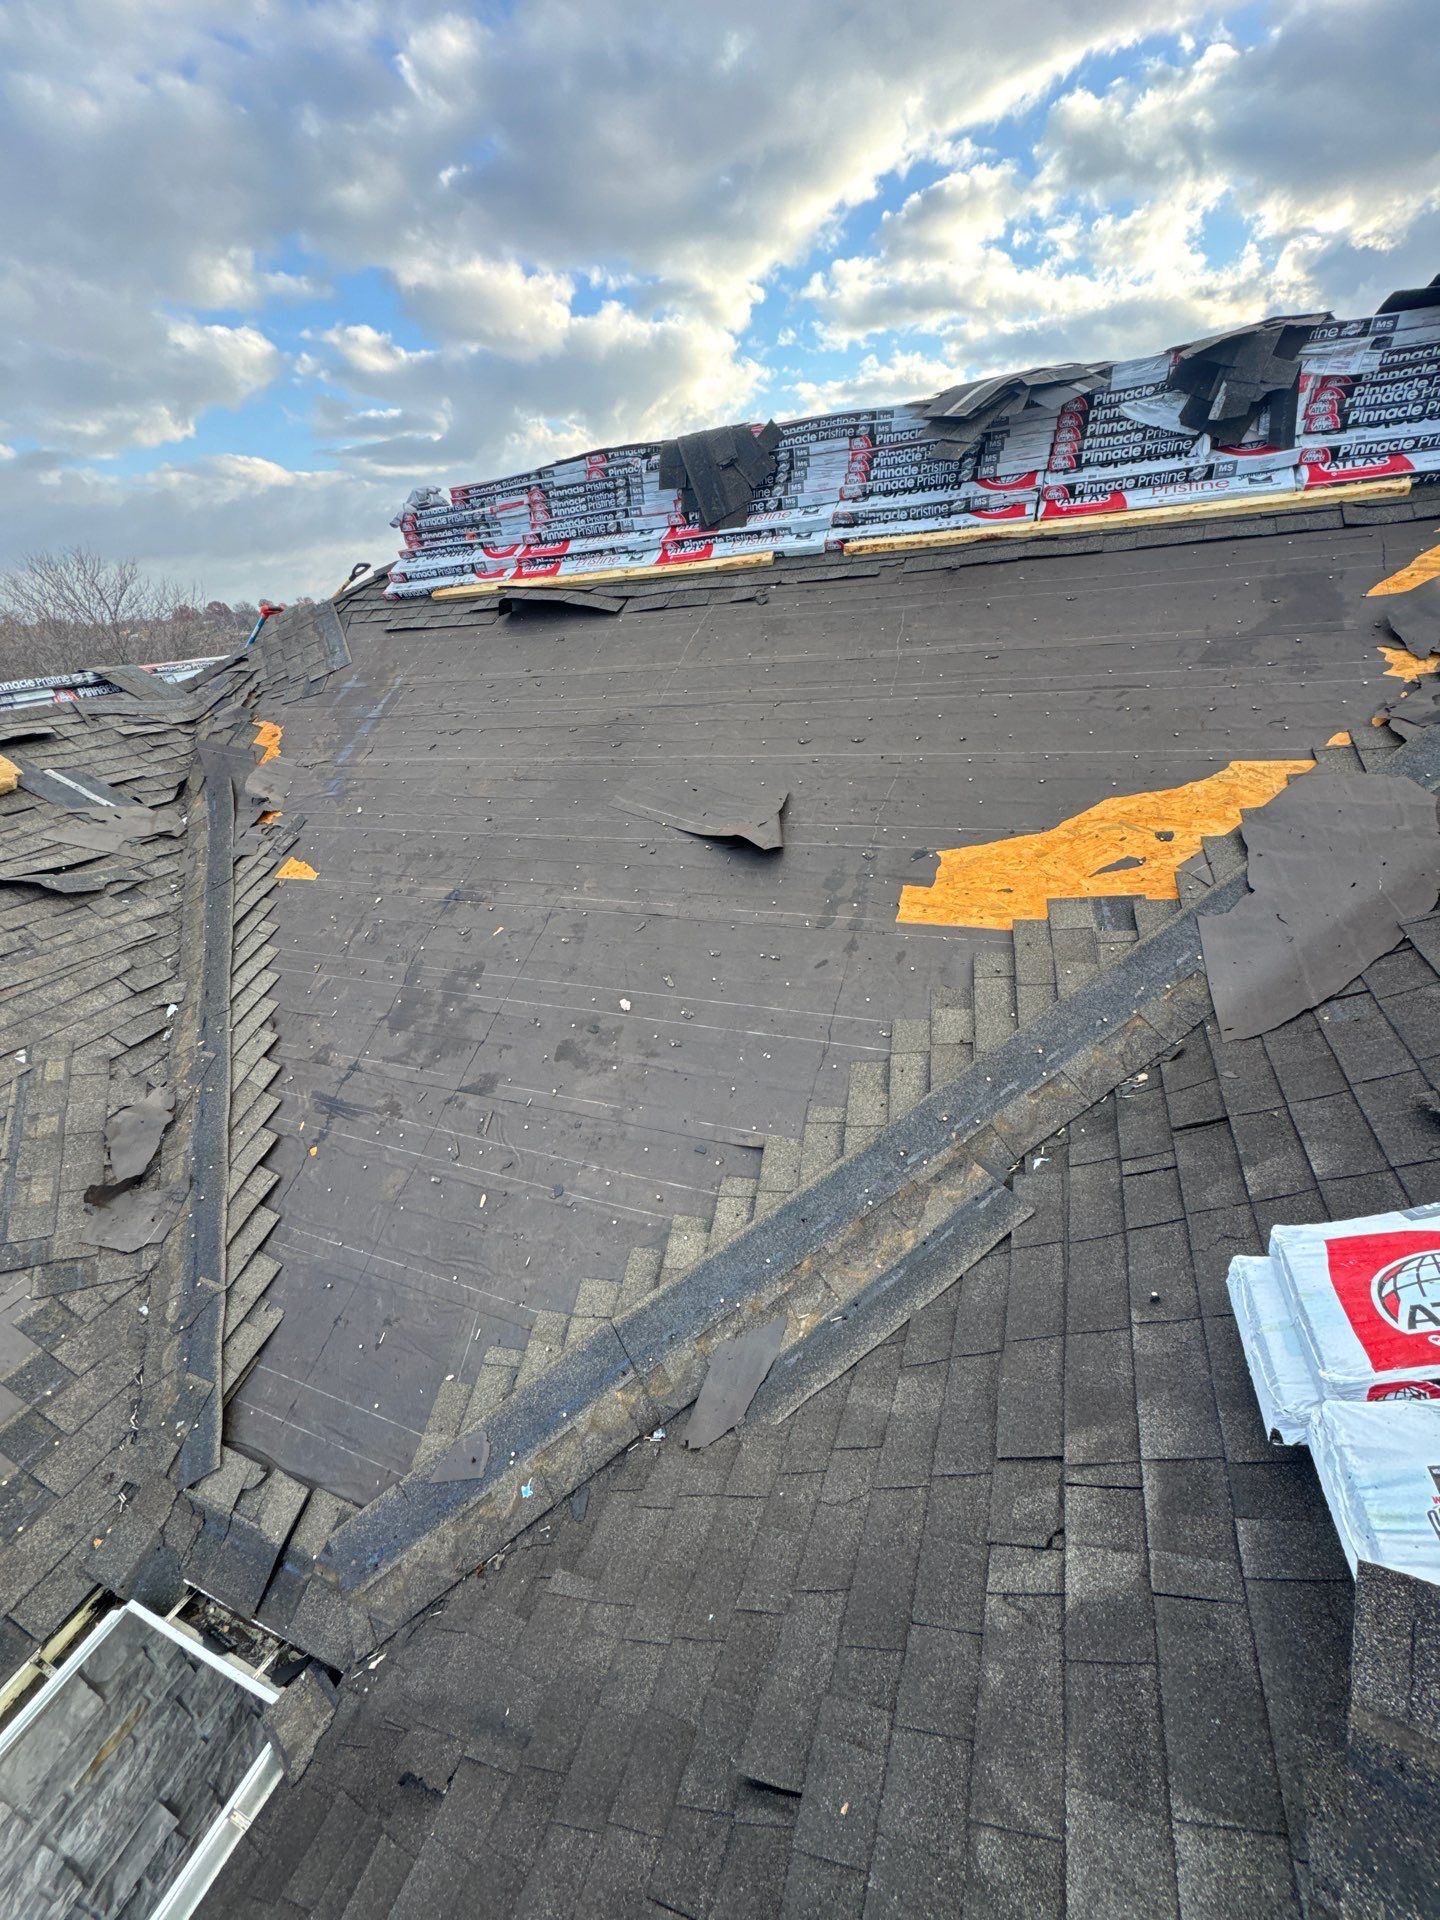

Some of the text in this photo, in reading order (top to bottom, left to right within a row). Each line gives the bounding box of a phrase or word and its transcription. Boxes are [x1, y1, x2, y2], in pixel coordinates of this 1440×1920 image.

[1376, 320, 1393, 328] MS
[1362, 364, 1438, 381] Pinnacle
[1094, 386, 1156, 406] Pinnacle
[1353, 378, 1429, 397] Pinnacle
[1344, 389, 1418, 408] Pinnacle
[1088, 407, 1121, 422] Pinn
[1347, 403, 1423, 424] Pinnacle
[778, 432, 818, 447] innacle
[818, 427, 855, 440] Pristine
[1084, 430, 1144, 450] Pinnacle
[1082, 445, 1142, 464] Pinnacle
[1144, 439, 1192, 456] Pristine
[1338, 439, 1416, 458] Pinnacle
[873, 452, 922, 468] Pinnacle
[870, 464, 918, 480] Pinnacle
[920, 460, 960, 474] Pristine
[1075, 478, 1136, 495] Pinnacle
[1138, 470, 1186, 488] Pristine
[1218, 463, 1234, 472] MS
[548, 485, 584, 498] Pinnacle
[586, 480, 614, 492] Pristine
[866, 466, 994, 494] Pinnacle Pristine MS
[552, 504, 587, 517] Pinnacle
[588, 498, 616, 510] Pristine
[910, 503, 949, 518] Pristine
[587, 512, 614, 523] Pristine
[541, 528, 576, 540] Pinnacle
[578, 523, 606, 537] Pristine
[407, 569, 438, 580] Pinnacle
[36, 674, 70, 686] Pristine
